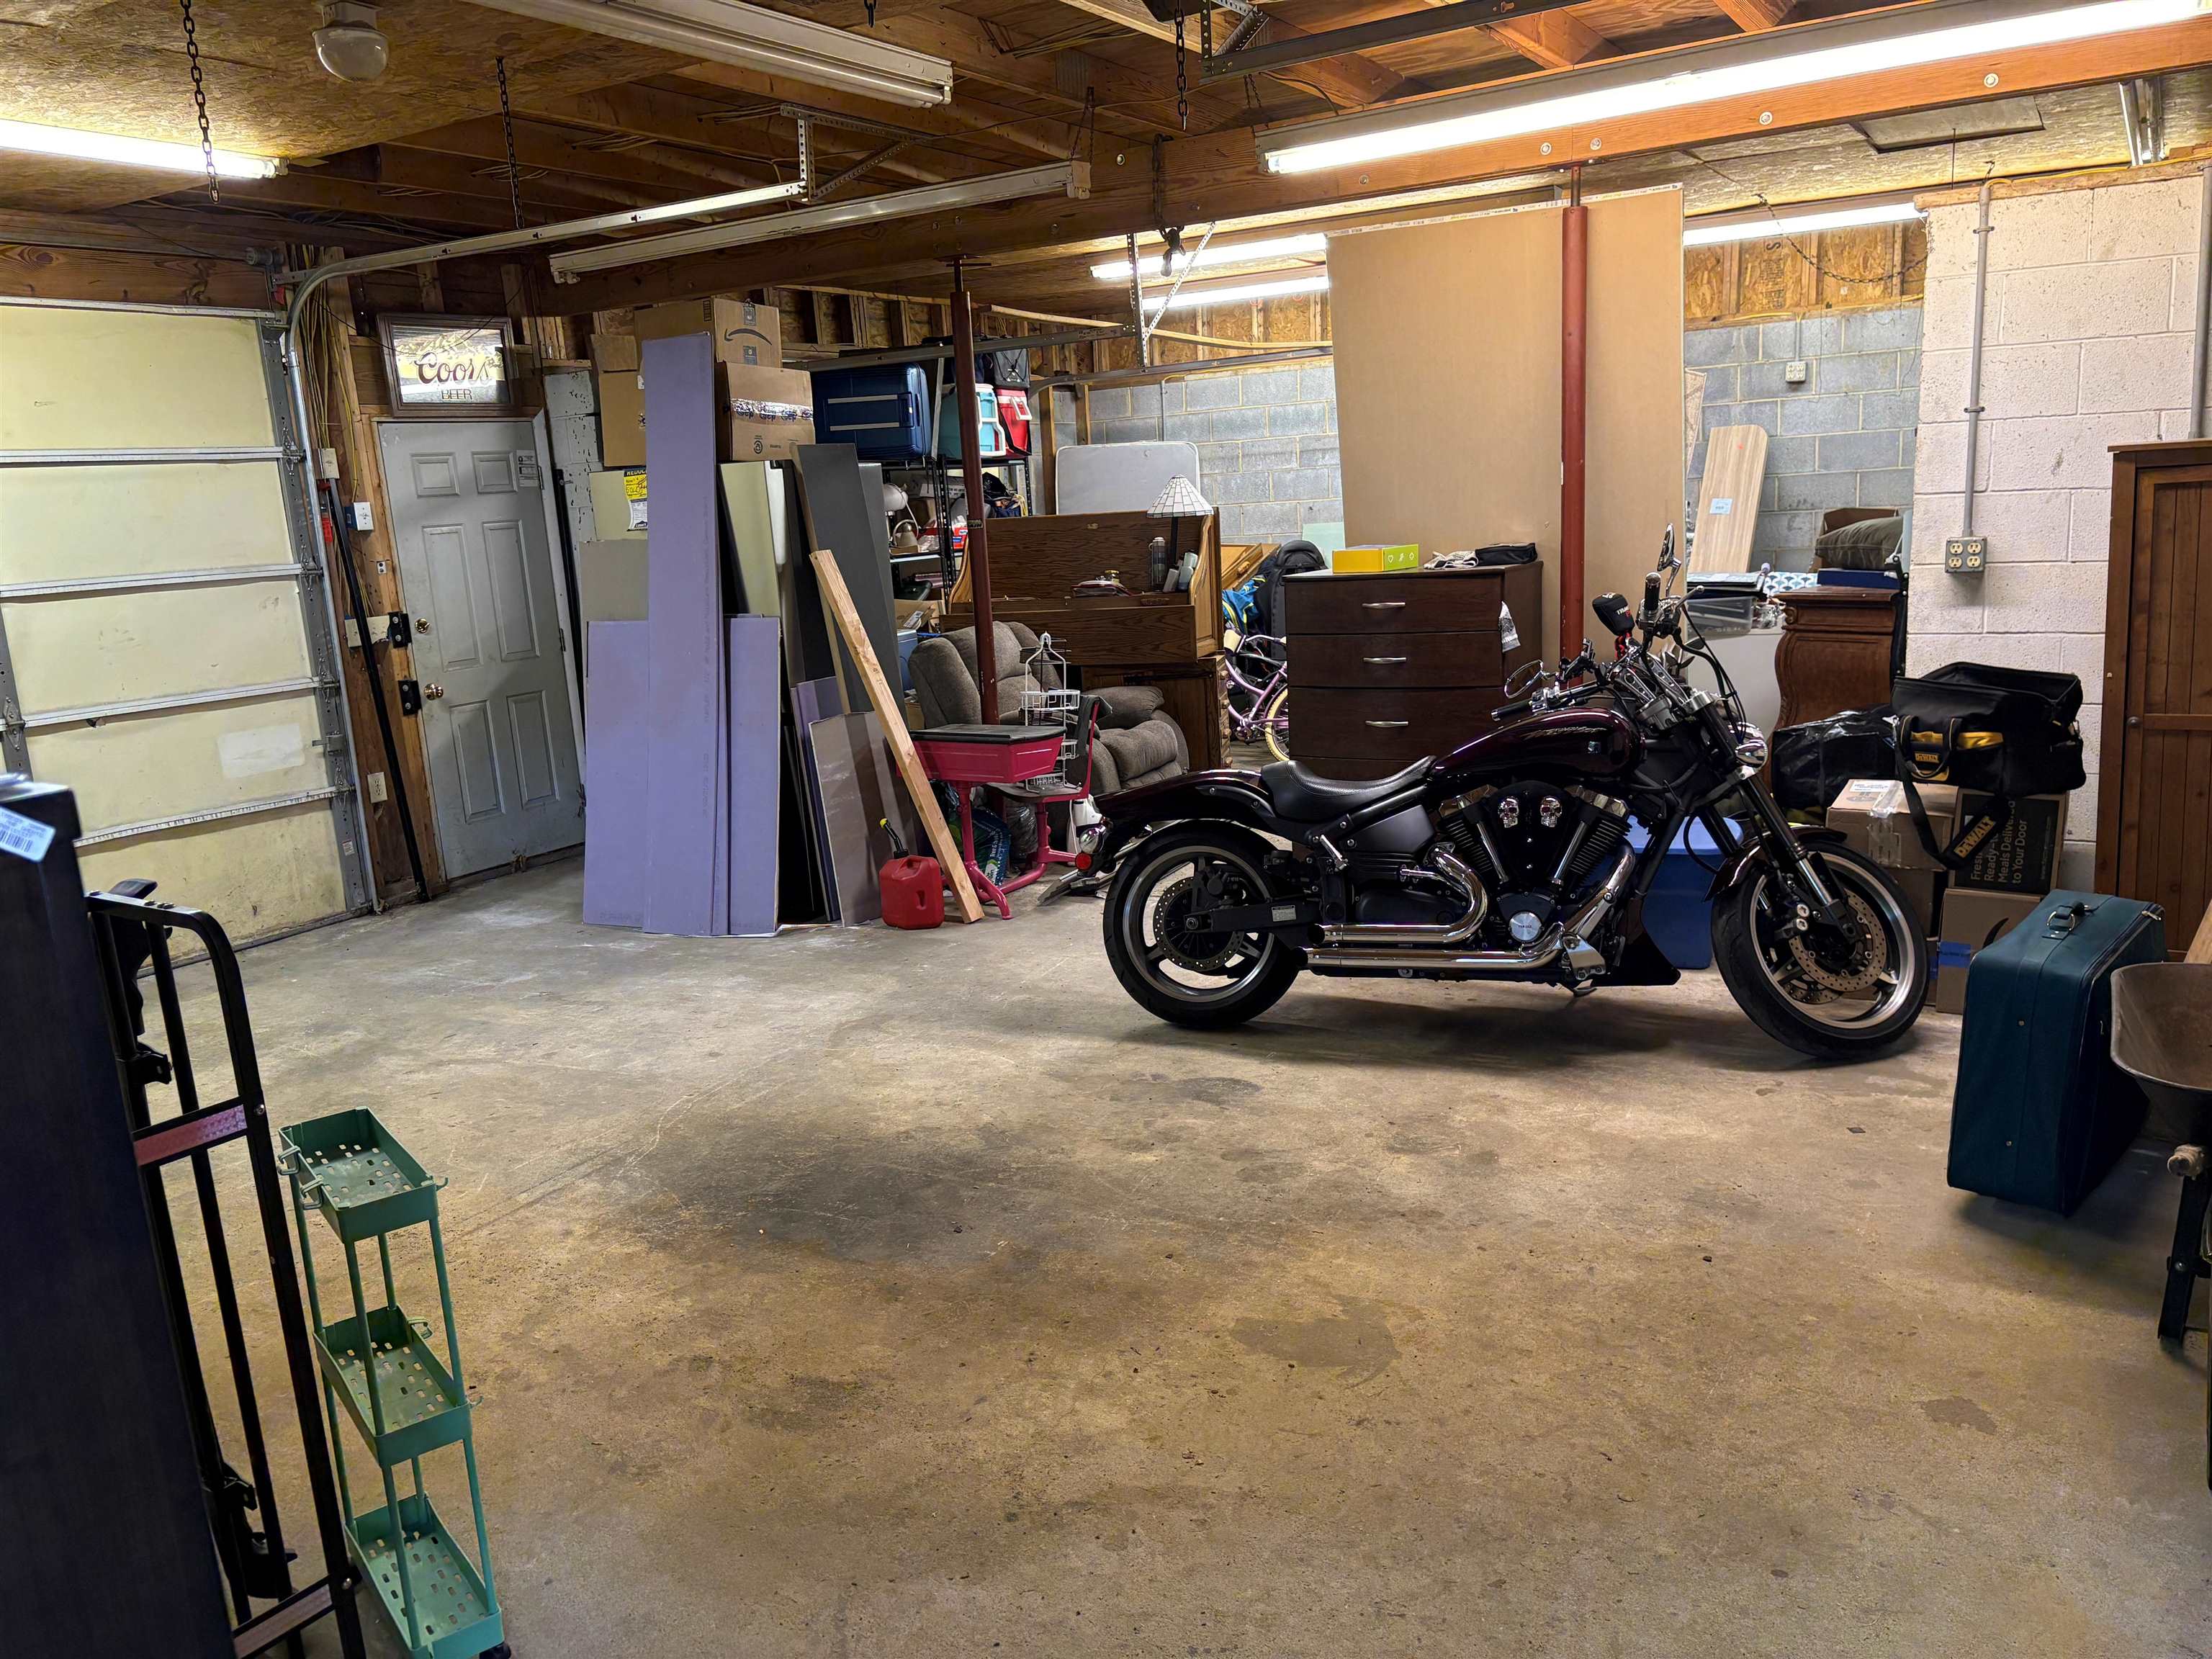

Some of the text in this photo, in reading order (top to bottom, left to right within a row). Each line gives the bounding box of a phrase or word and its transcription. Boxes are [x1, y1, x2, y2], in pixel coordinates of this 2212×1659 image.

[414, 352, 493, 385] Coors
[441, 388, 473, 400] BEER
[2012, 819, 2028, 884] to Your Door
[1997, 853, 2010, 883] Meals
